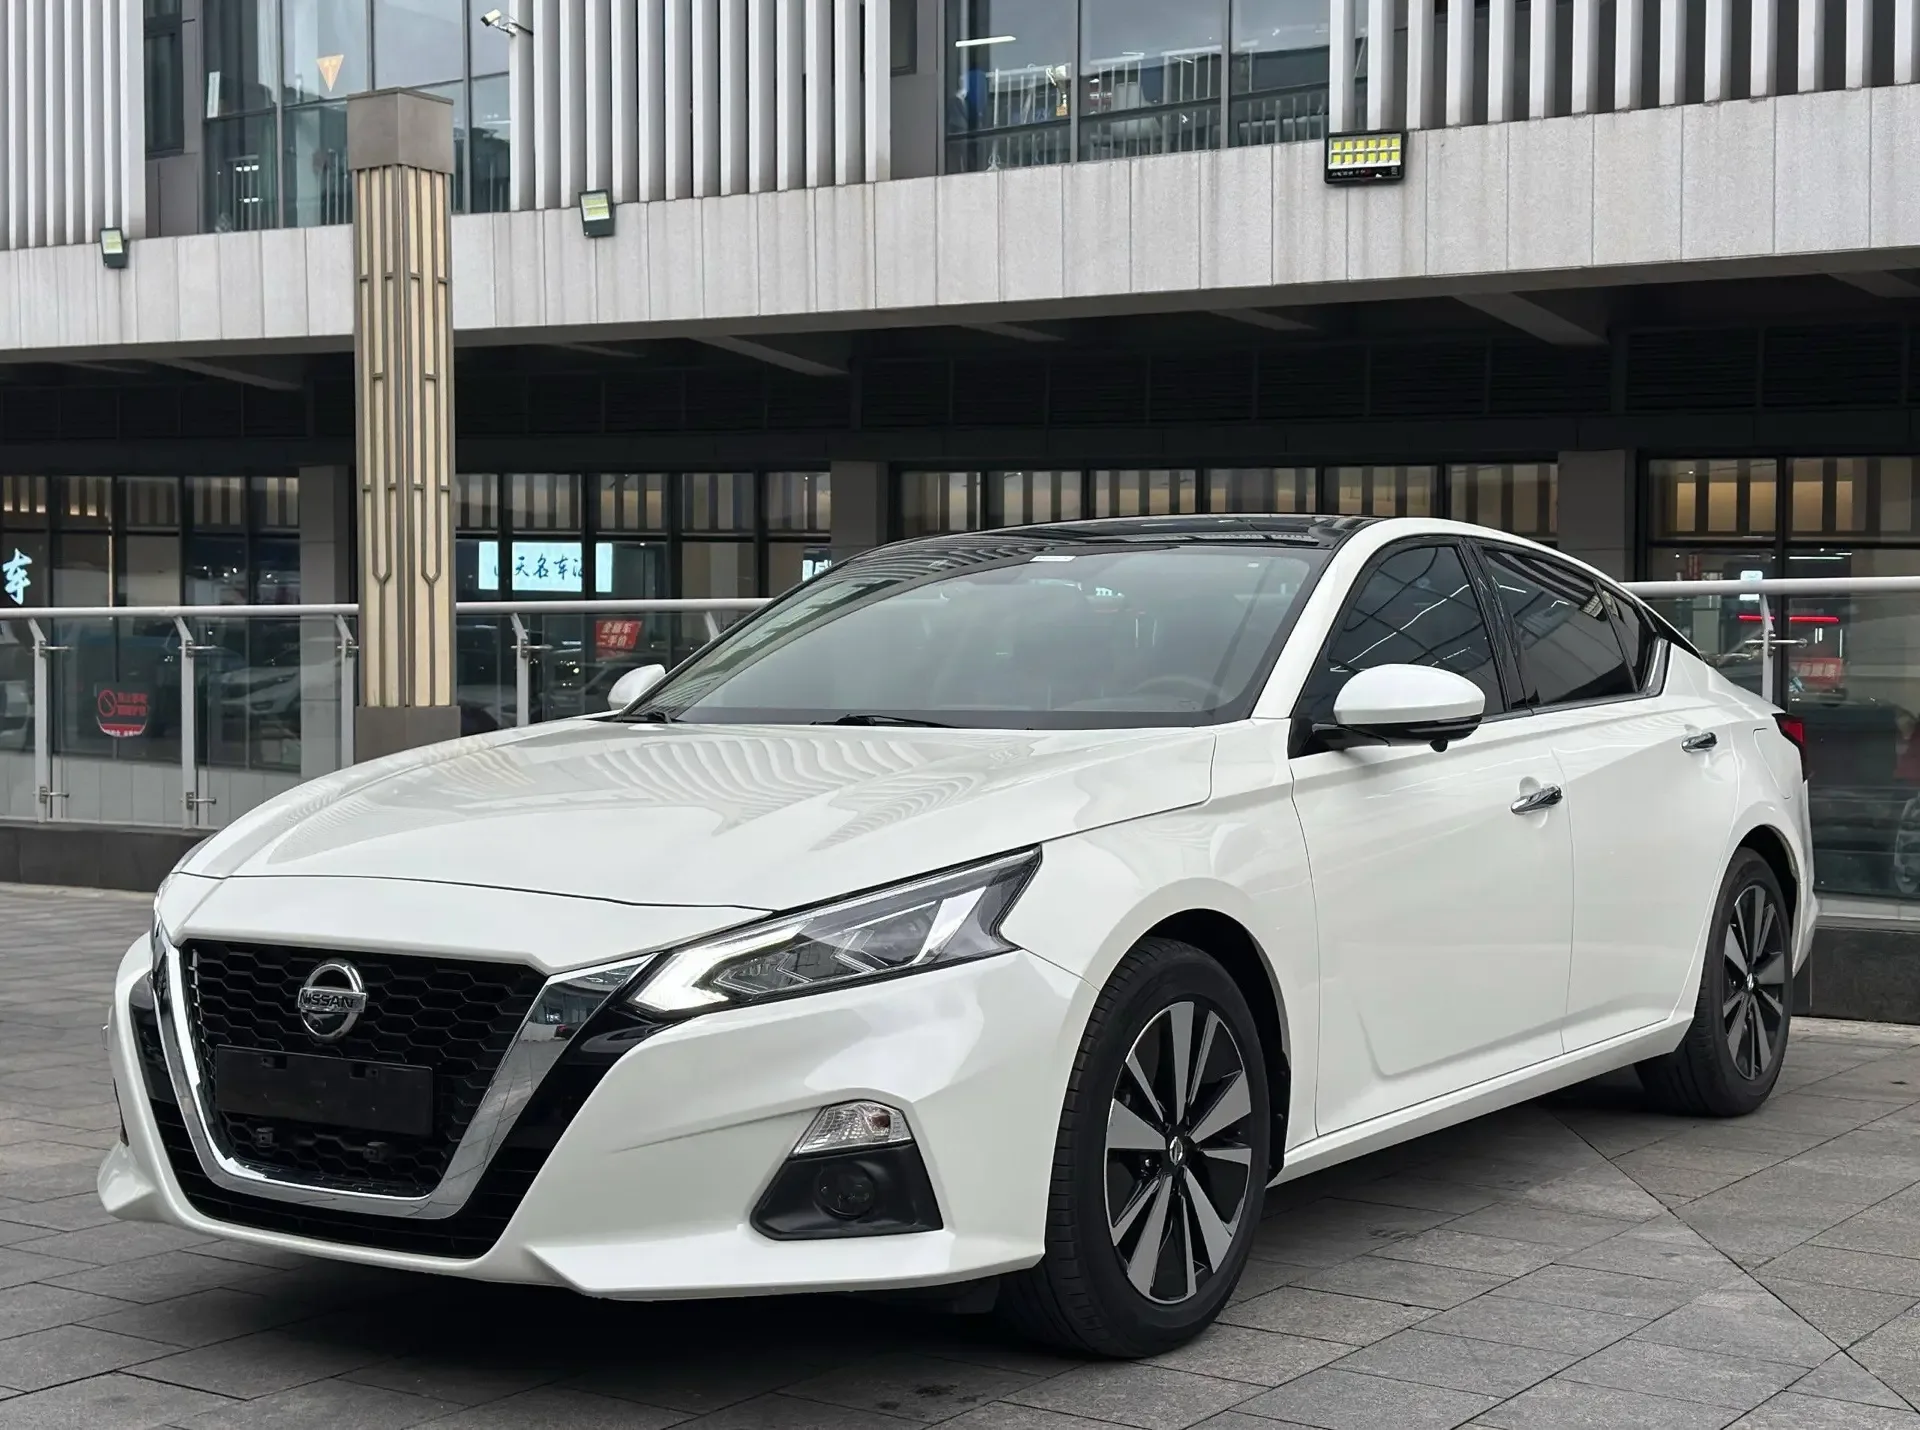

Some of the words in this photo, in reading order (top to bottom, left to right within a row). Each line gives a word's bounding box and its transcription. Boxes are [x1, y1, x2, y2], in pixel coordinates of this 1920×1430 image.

[2, 548, 33, 604] 车
[494, 553, 583, 580] 天名车
[301, 990, 354, 1009] NISSAN
